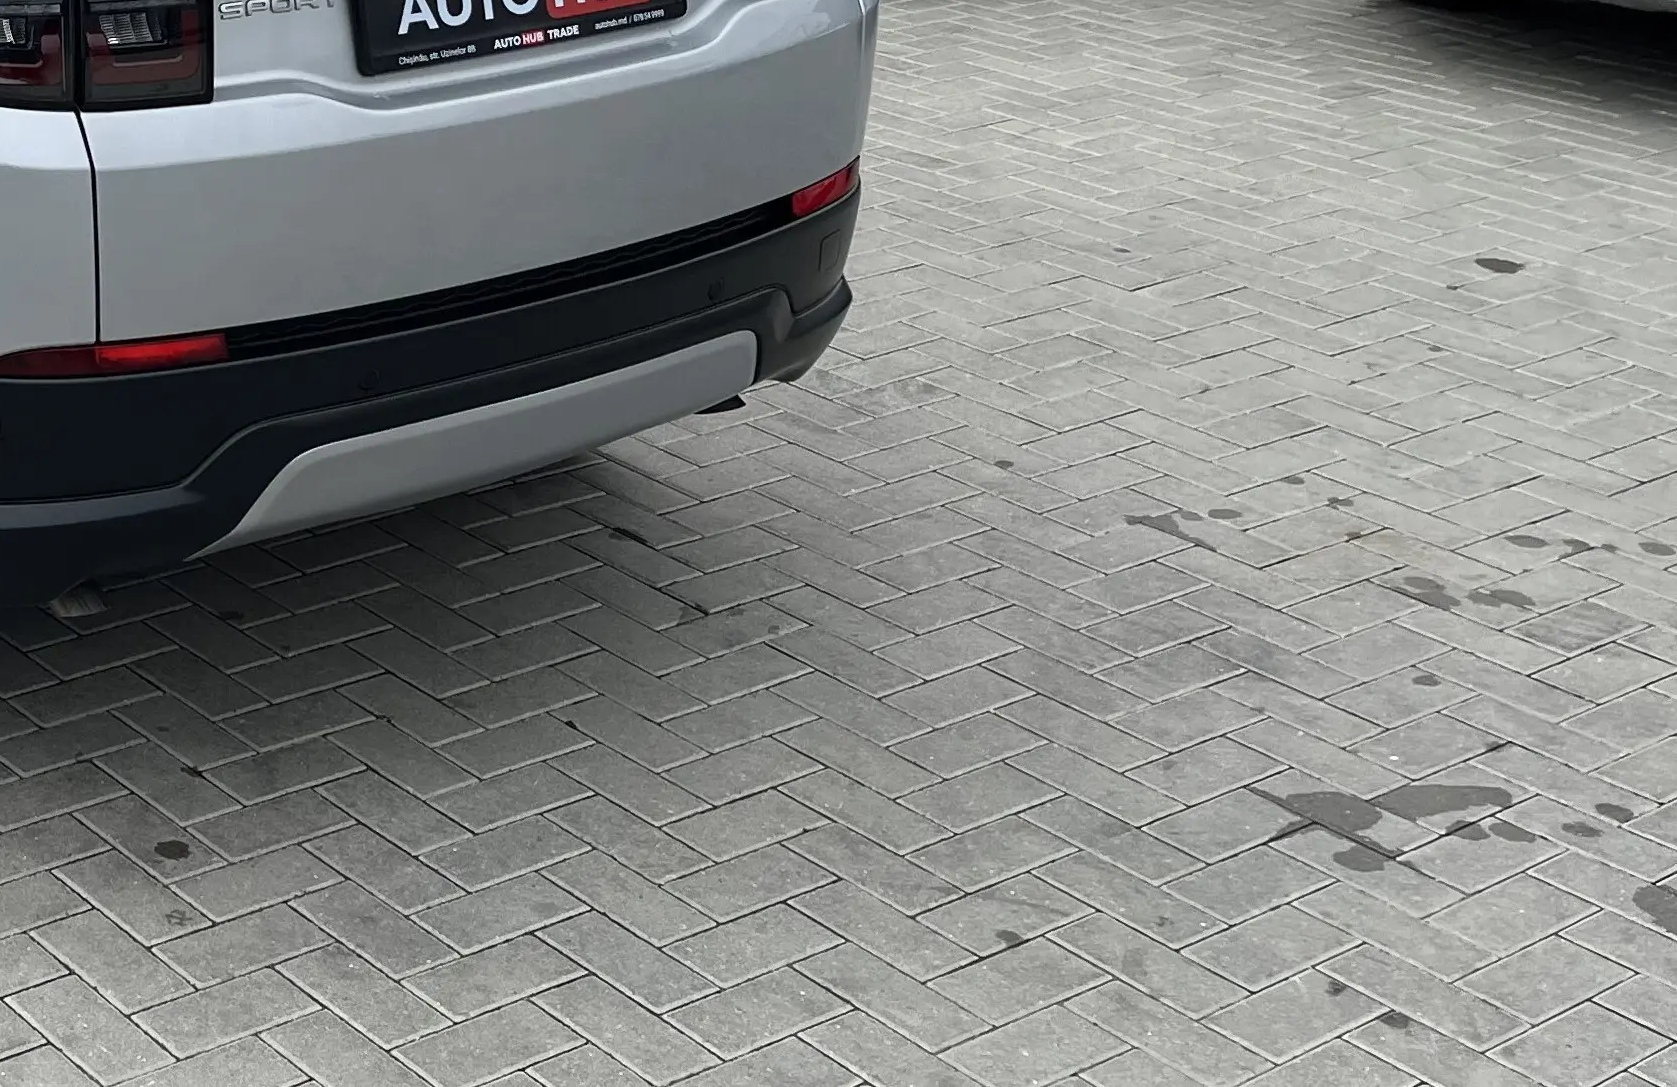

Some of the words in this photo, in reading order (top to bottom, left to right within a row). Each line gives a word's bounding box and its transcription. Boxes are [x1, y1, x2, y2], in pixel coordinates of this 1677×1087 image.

[494, 35, 521, 50] AUTO
[522, 30, 544, 45] HUB
[547, 24, 580, 40] TRADE
